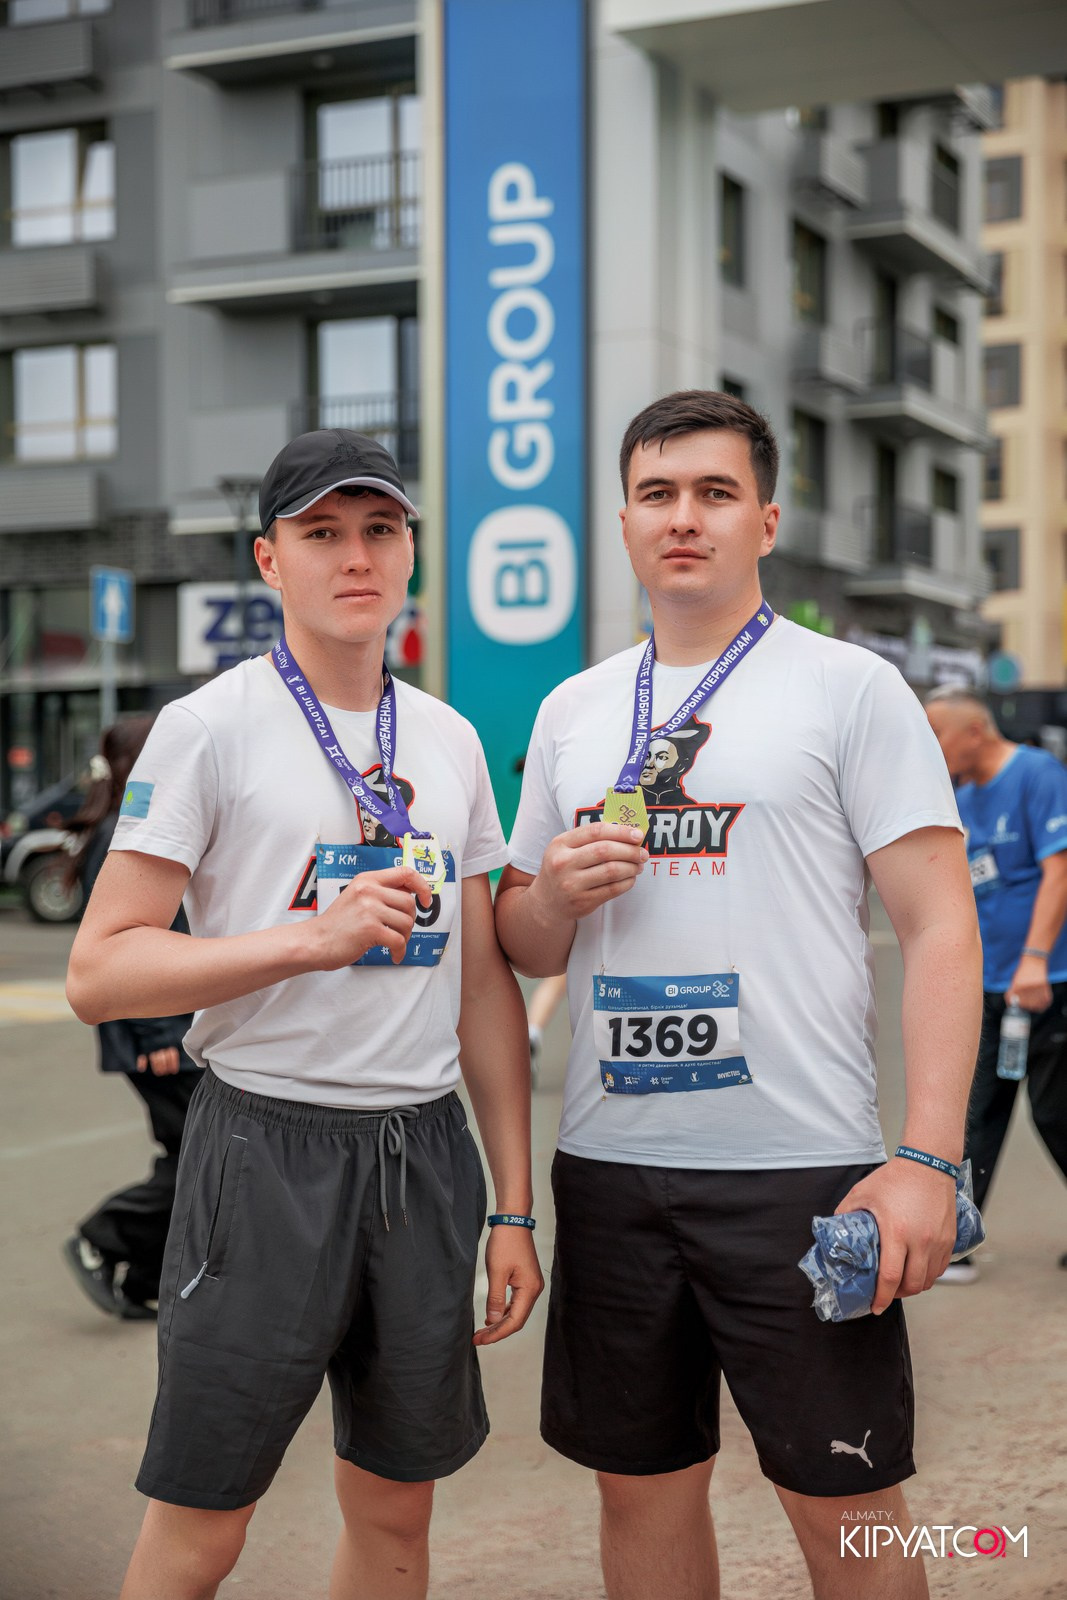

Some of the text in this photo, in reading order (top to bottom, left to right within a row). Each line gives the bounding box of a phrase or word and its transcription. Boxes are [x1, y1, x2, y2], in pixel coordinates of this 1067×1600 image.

[487, 161, 555, 609] BI GROUP
[277, 651, 290, 669] City
[666, 689, 706, 732] ДОБРЫМ
[701, 630, 754, 691] ПЕРЕМЕНАМ
[296, 685, 330, 738] BI JULDYZAI
[637, 688, 650, 730] ДОБРЫМ
[360, 796, 383, 815] GROUP
[323, 850, 335, 865] 5
[651, 861, 726, 876] TEAM
[599, 983, 606, 998] 5
[680, 985, 712, 994] GROUP
[608, 1013, 718, 1058] 1369
[509, 1216, 525, 1225] 2025
